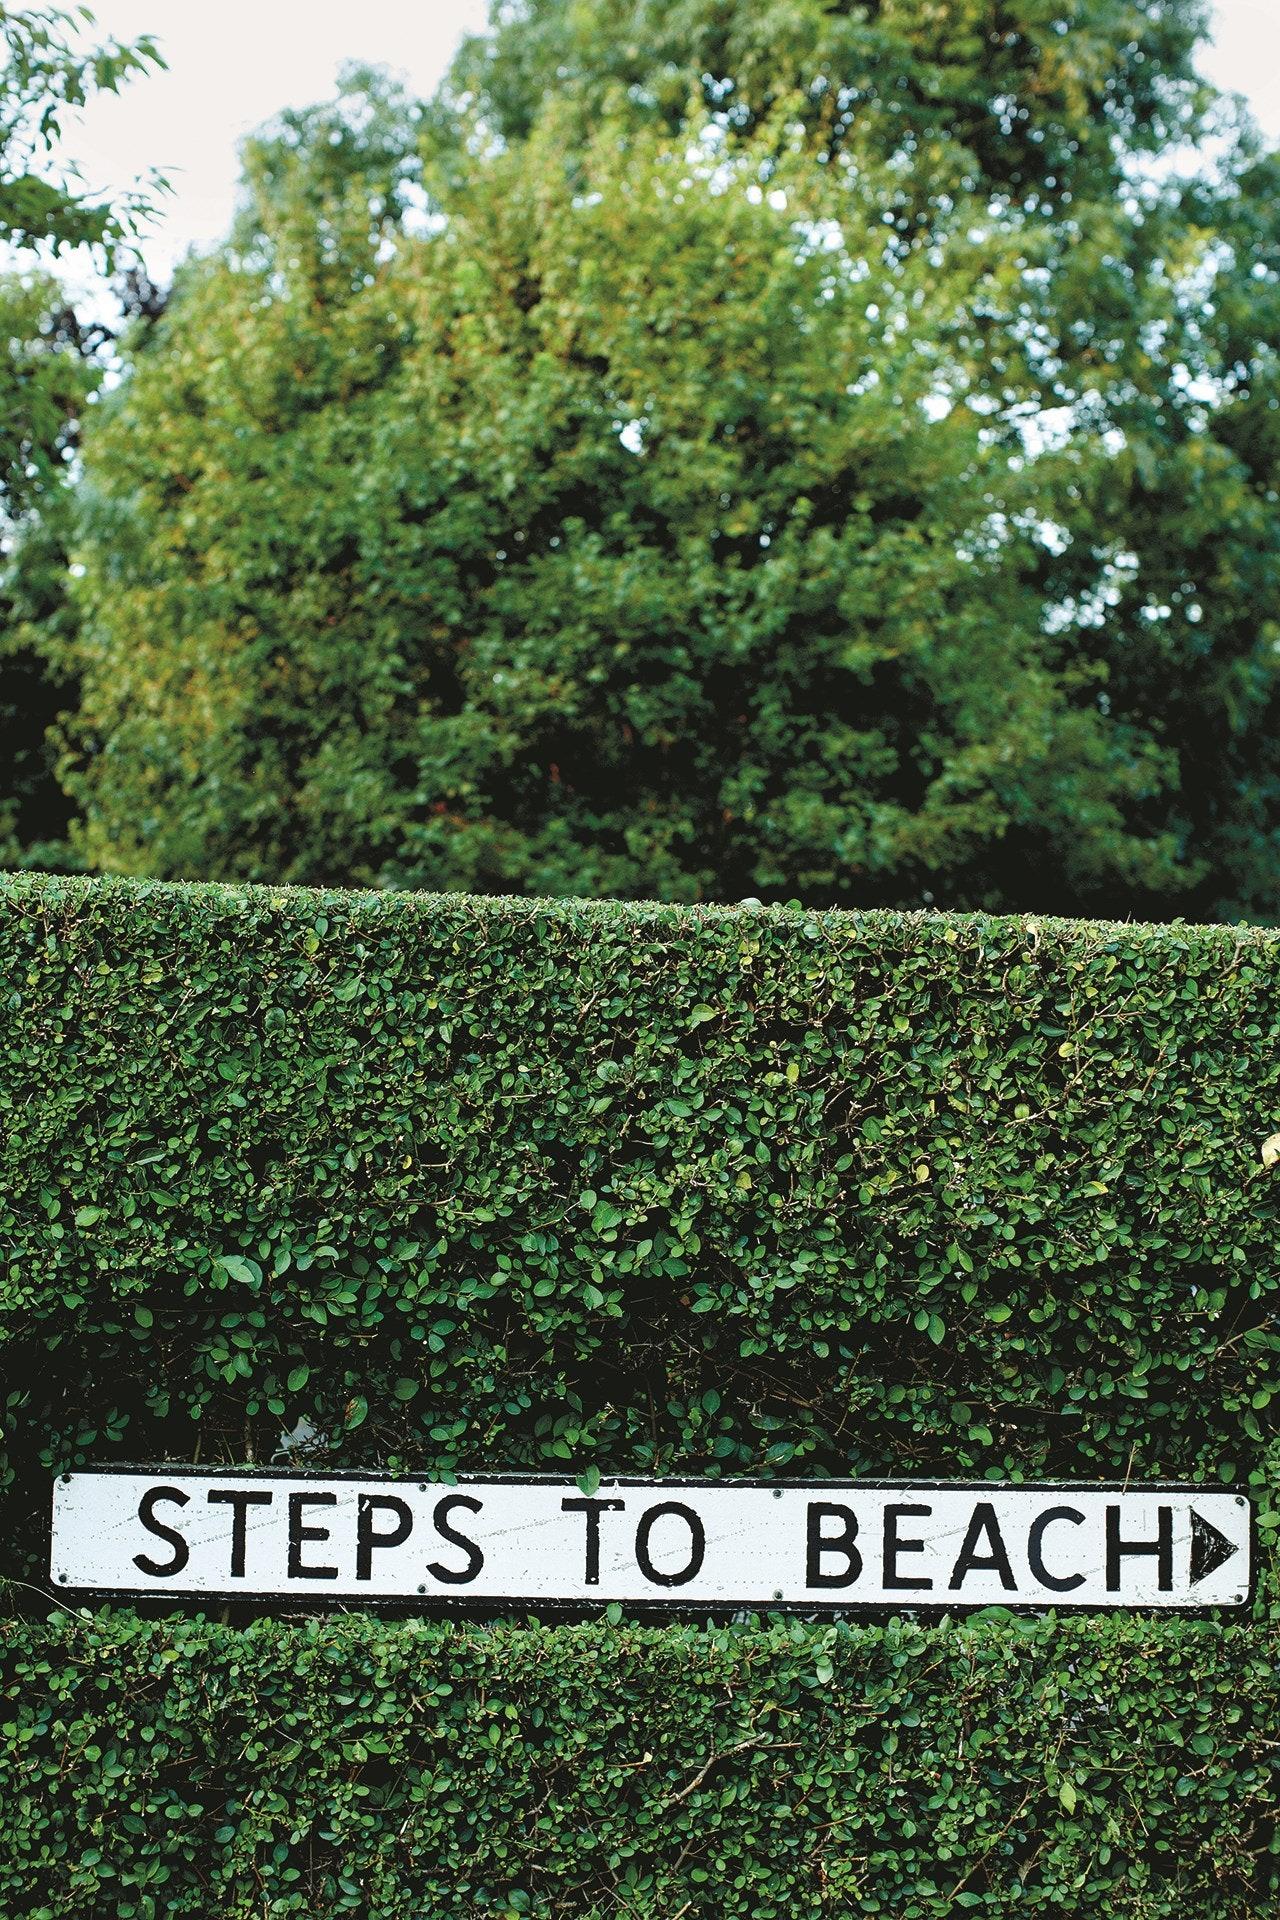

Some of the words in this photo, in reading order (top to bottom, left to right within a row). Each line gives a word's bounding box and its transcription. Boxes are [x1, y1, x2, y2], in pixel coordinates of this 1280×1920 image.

[131, 1485, 485, 1585] STEPS
[560, 1497, 707, 1588] TO
[805, 1501, 1174, 1593] BEACH
